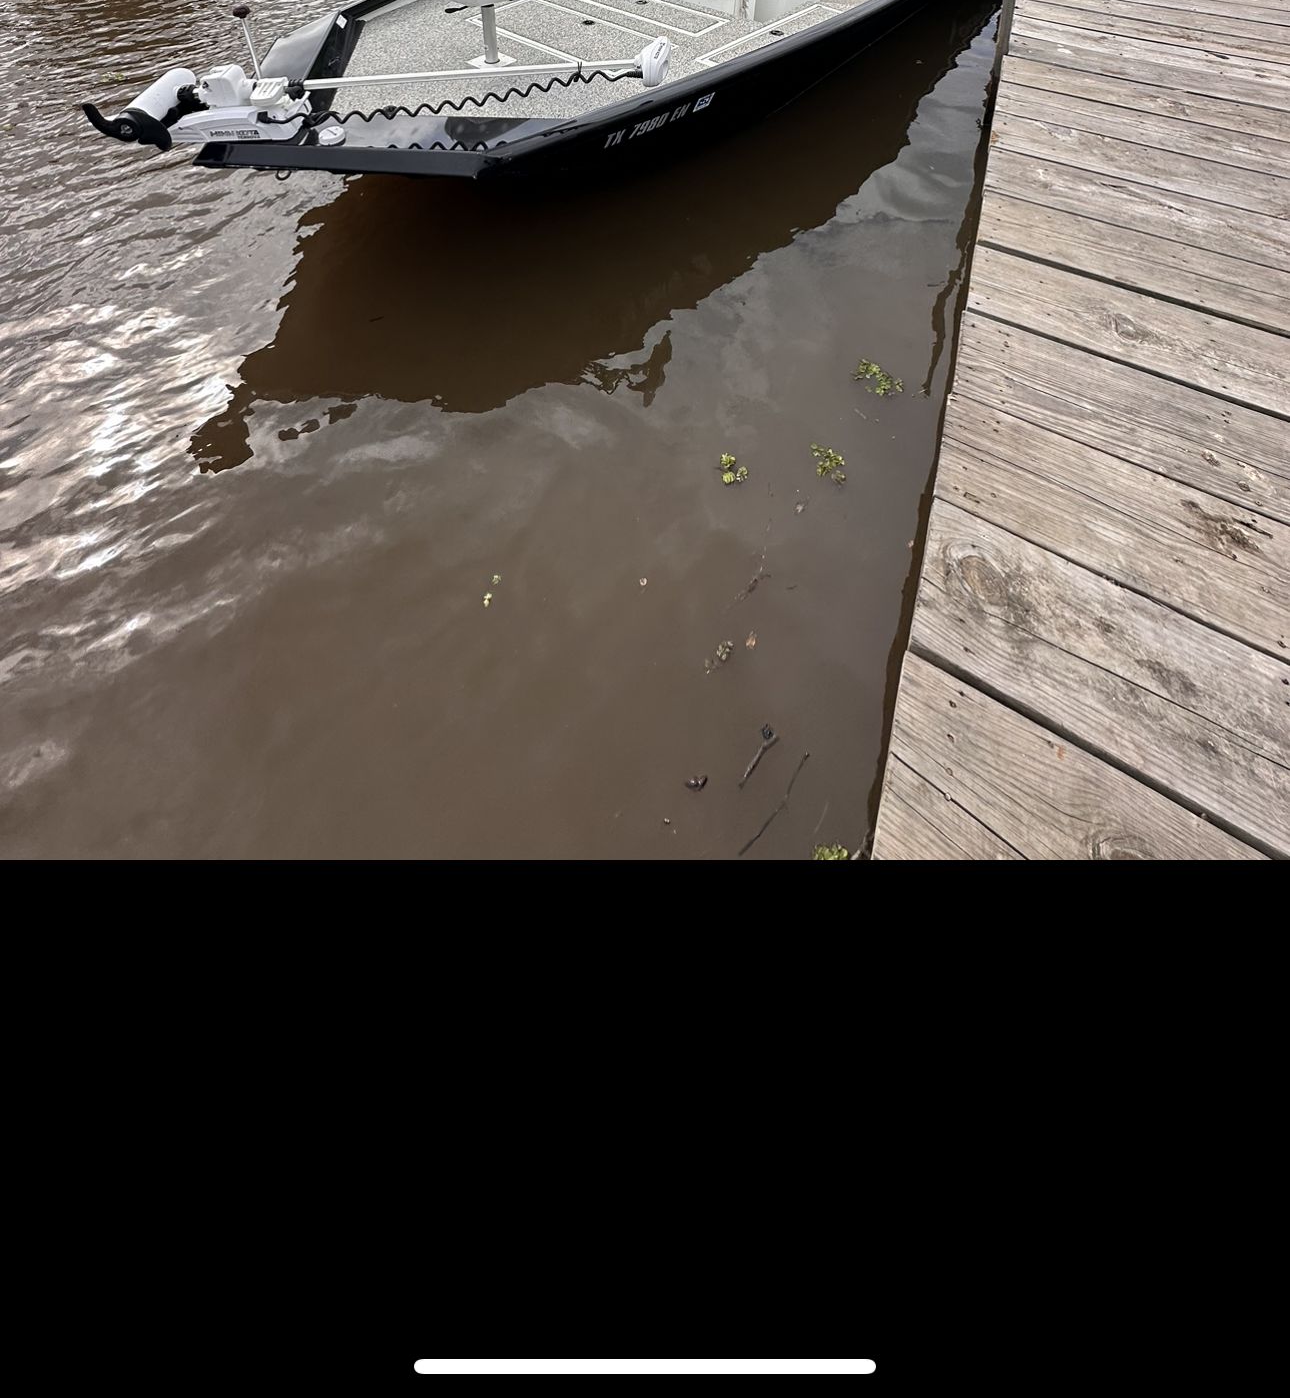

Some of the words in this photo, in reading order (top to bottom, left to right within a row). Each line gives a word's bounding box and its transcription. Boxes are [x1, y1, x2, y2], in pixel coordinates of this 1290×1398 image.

[603, 128, 626, 149] TX
[628, 111, 670, 139] 7980
[669, 102, 691, 122] EN
